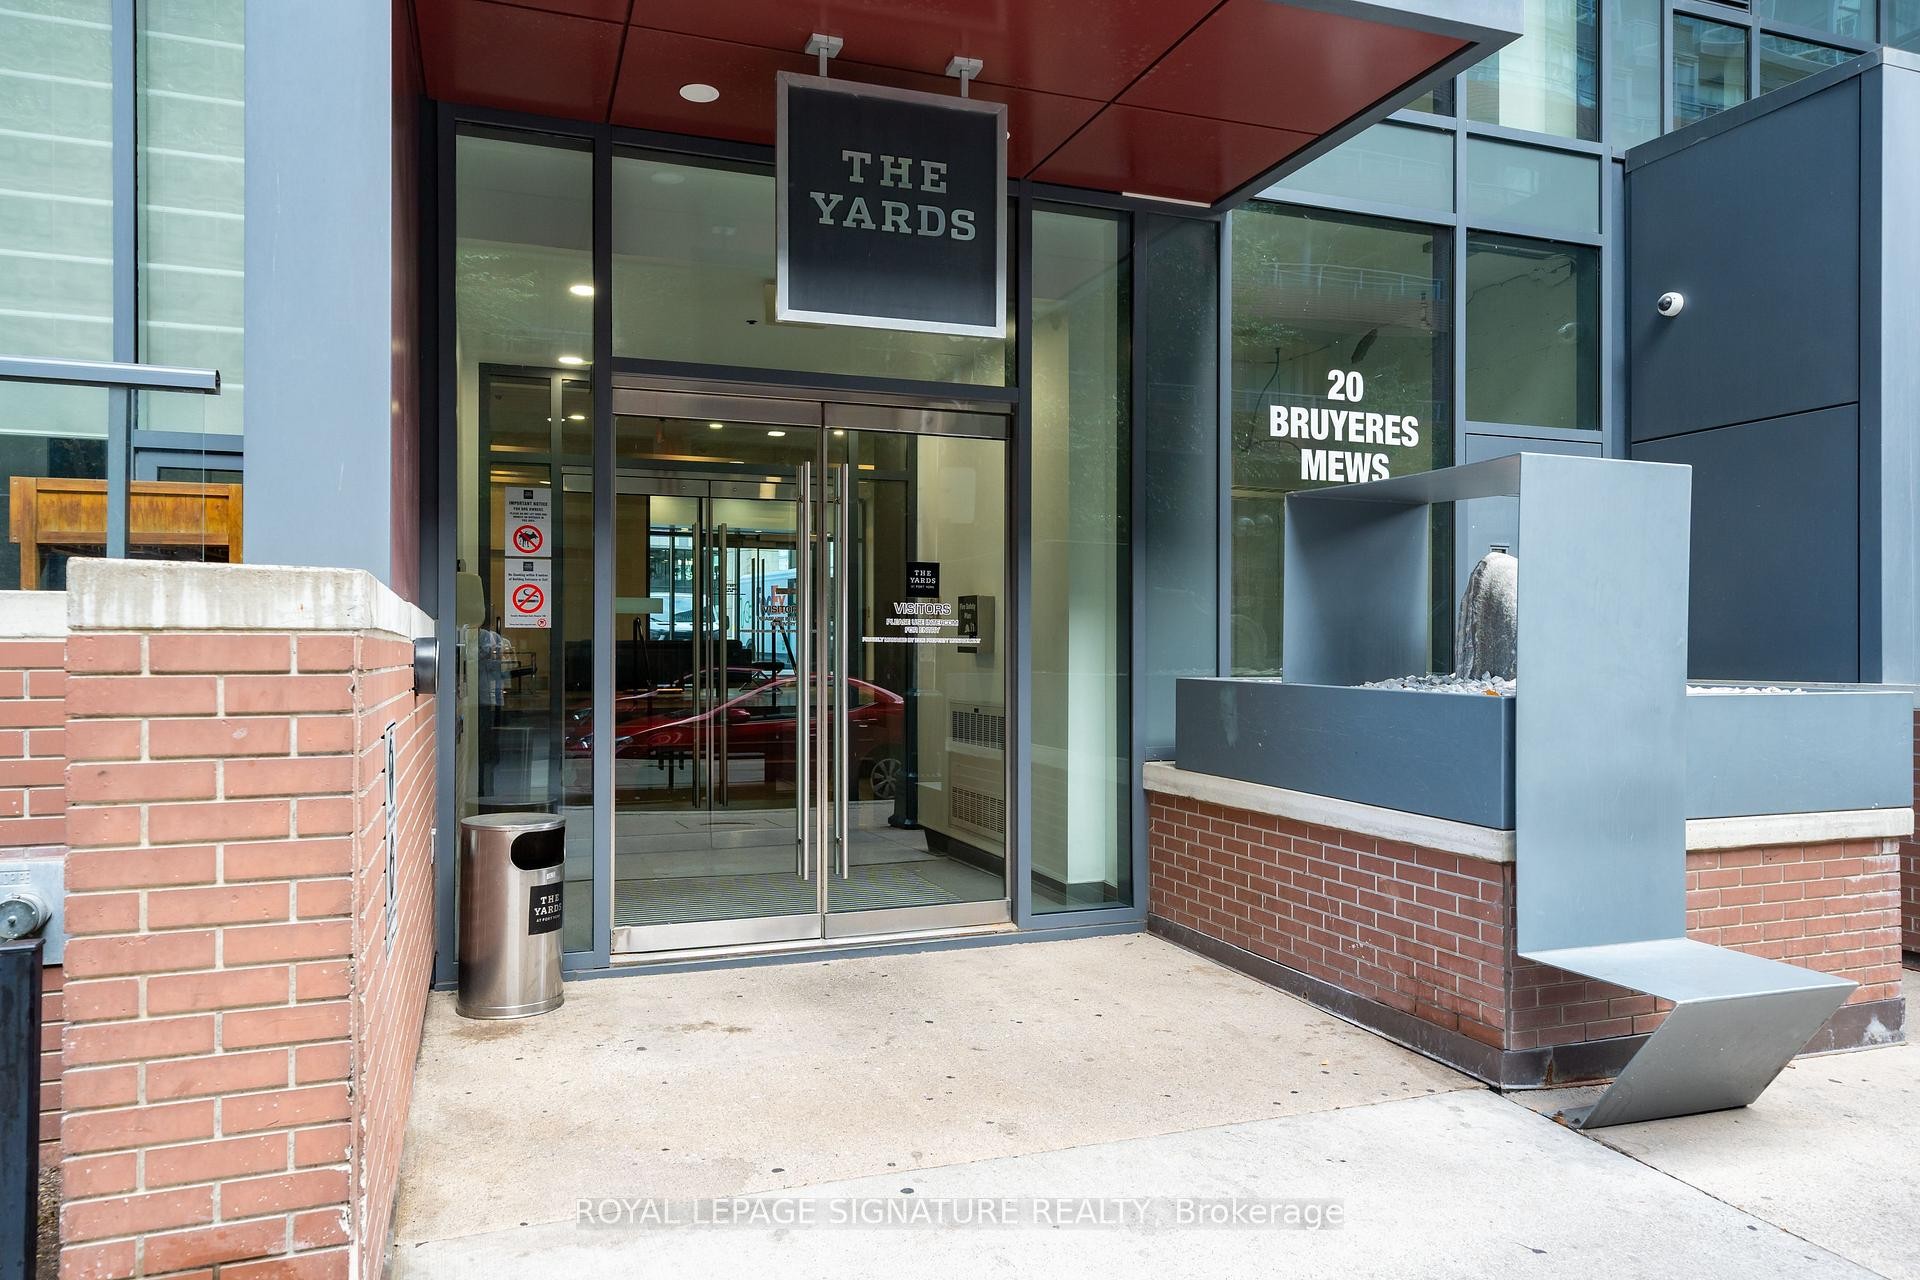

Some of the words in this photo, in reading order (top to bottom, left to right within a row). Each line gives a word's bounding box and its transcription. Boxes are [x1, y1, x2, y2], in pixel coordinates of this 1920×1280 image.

[842, 150, 948, 194] THE
[810, 192, 976, 240] YARDS
[1327, 369, 1364, 402] 20
[1270, 404, 1420, 448] BRUYERES
[1301, 448, 1390, 482] MEWS
[894, 602, 951, 615] VISITORS
[534, 903, 562, 916] YARDS
[540, 894, 560, 904] THE
